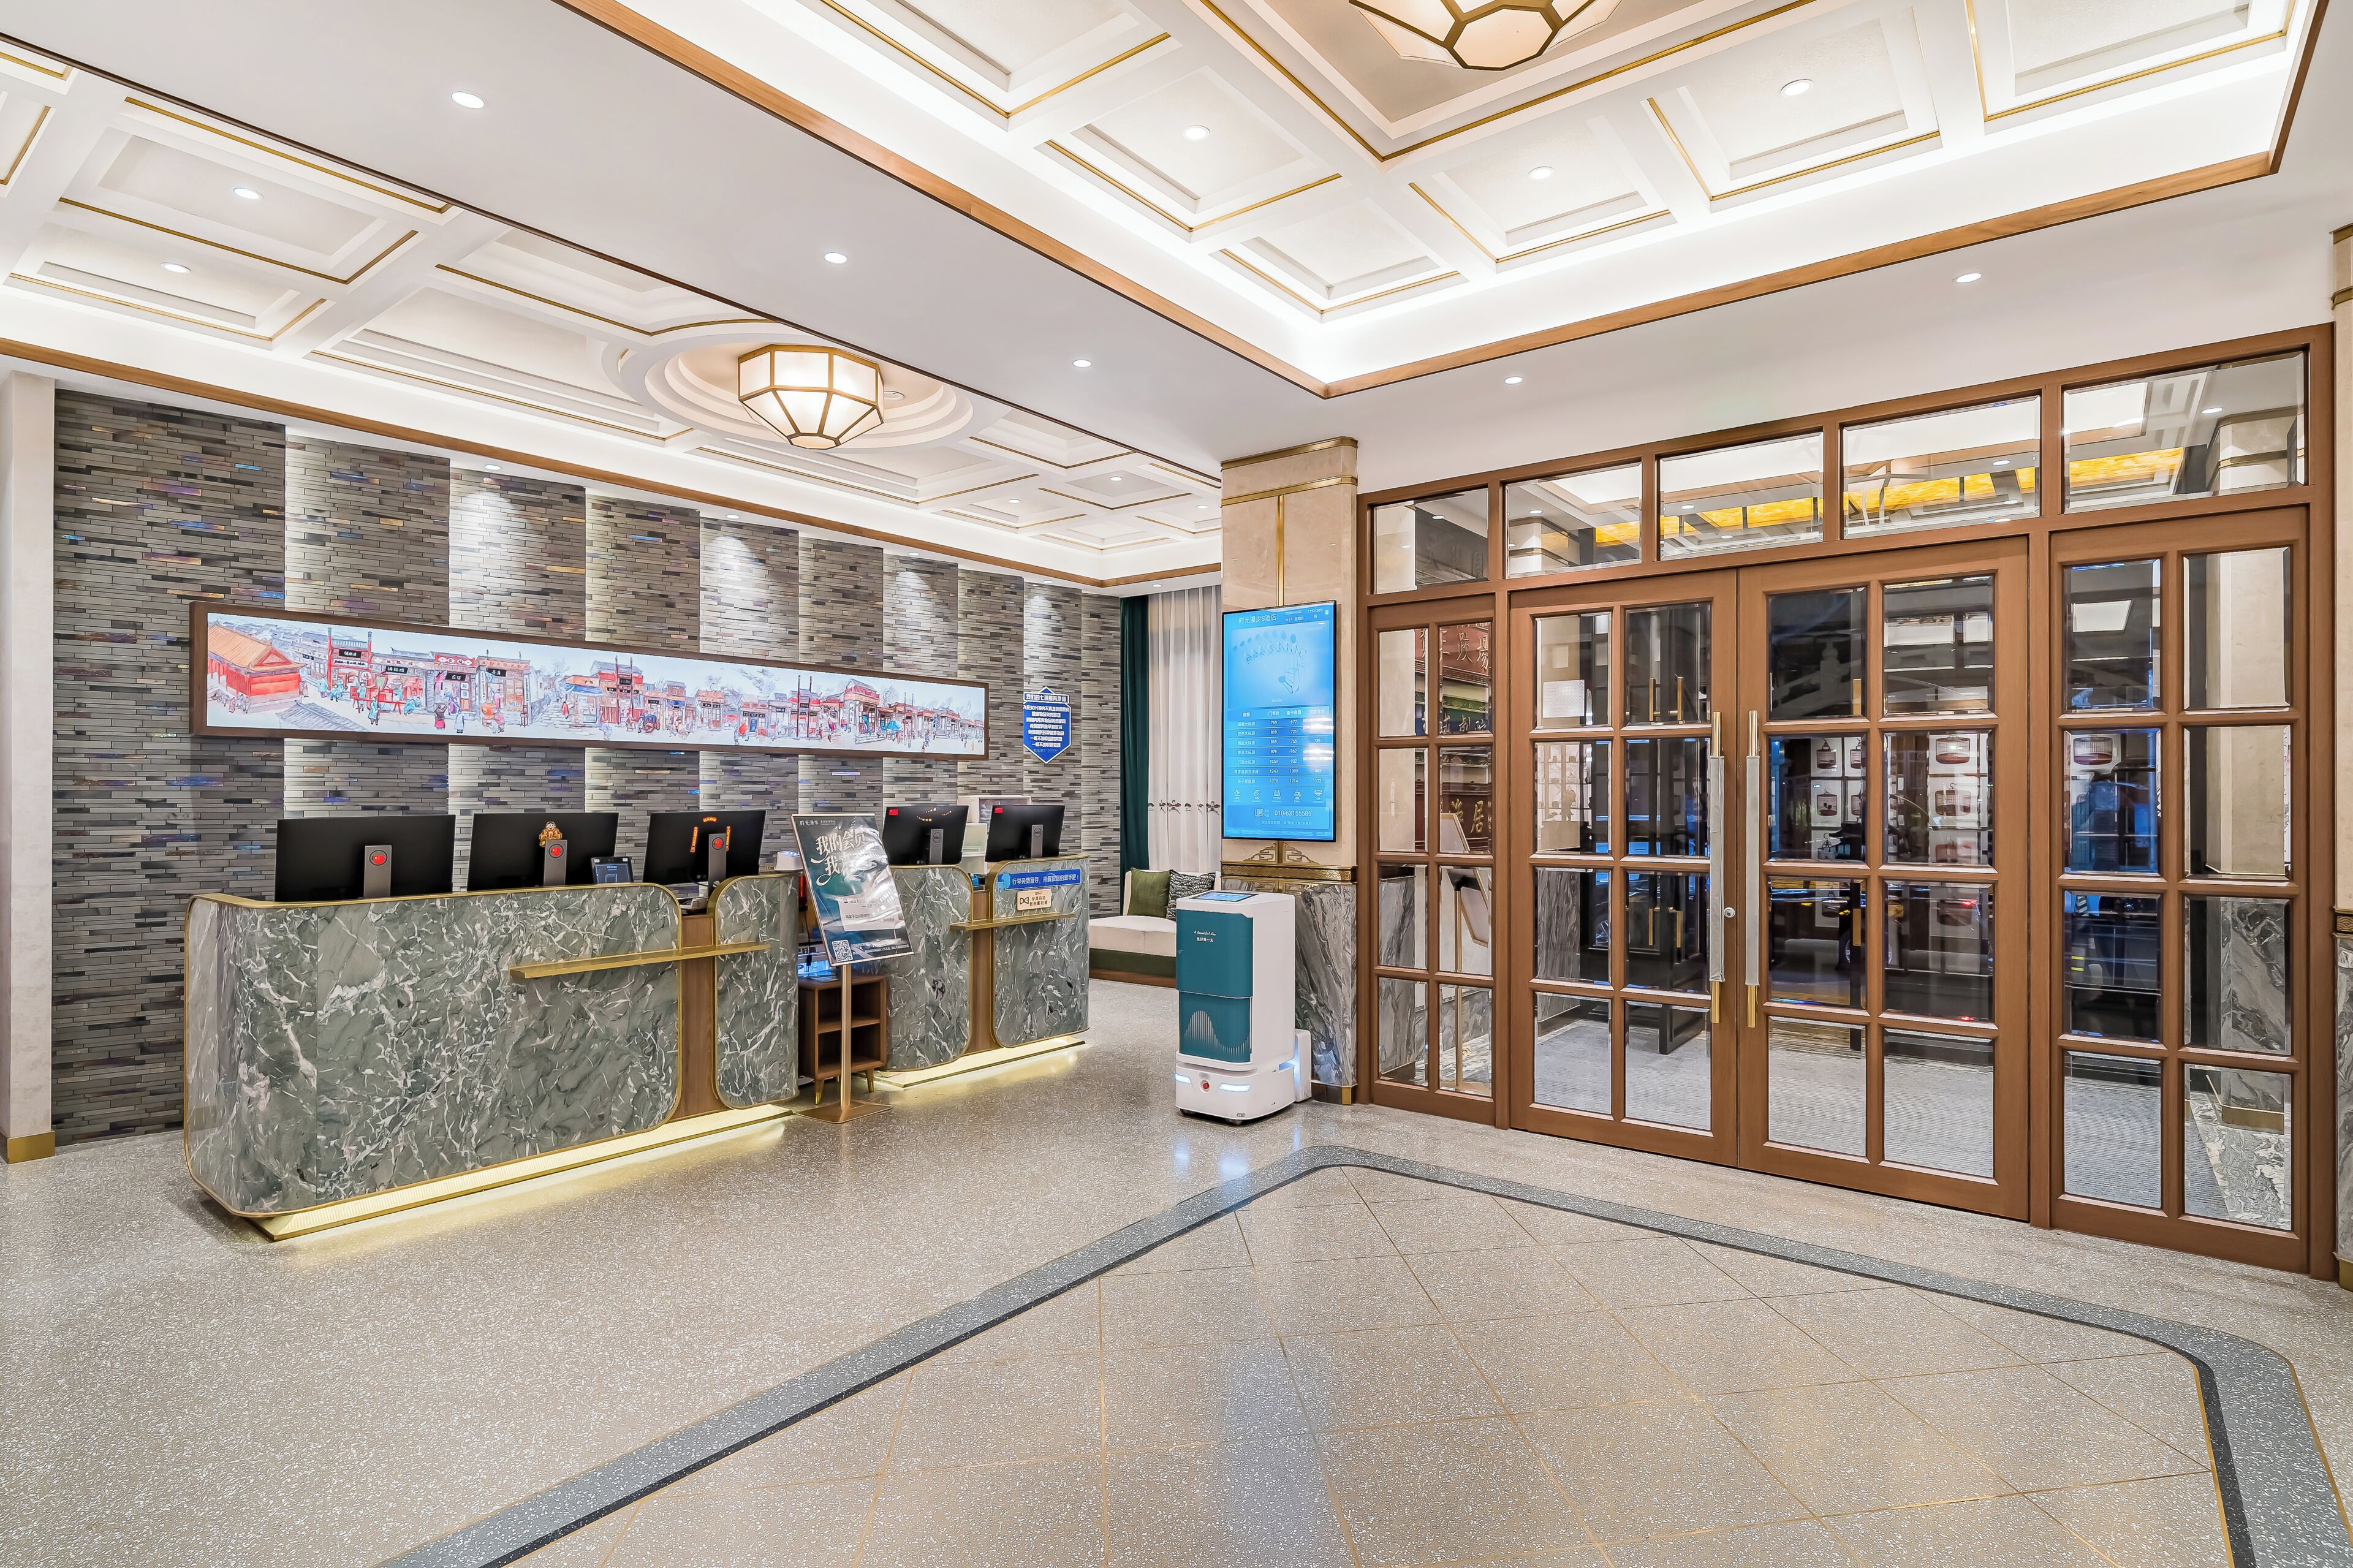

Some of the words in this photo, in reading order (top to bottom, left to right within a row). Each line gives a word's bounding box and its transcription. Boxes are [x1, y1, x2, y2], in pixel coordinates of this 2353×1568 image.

[1239, 614, 1276, 623] 时光漫步S酒店
[811, 829, 865, 863] 我的会员
